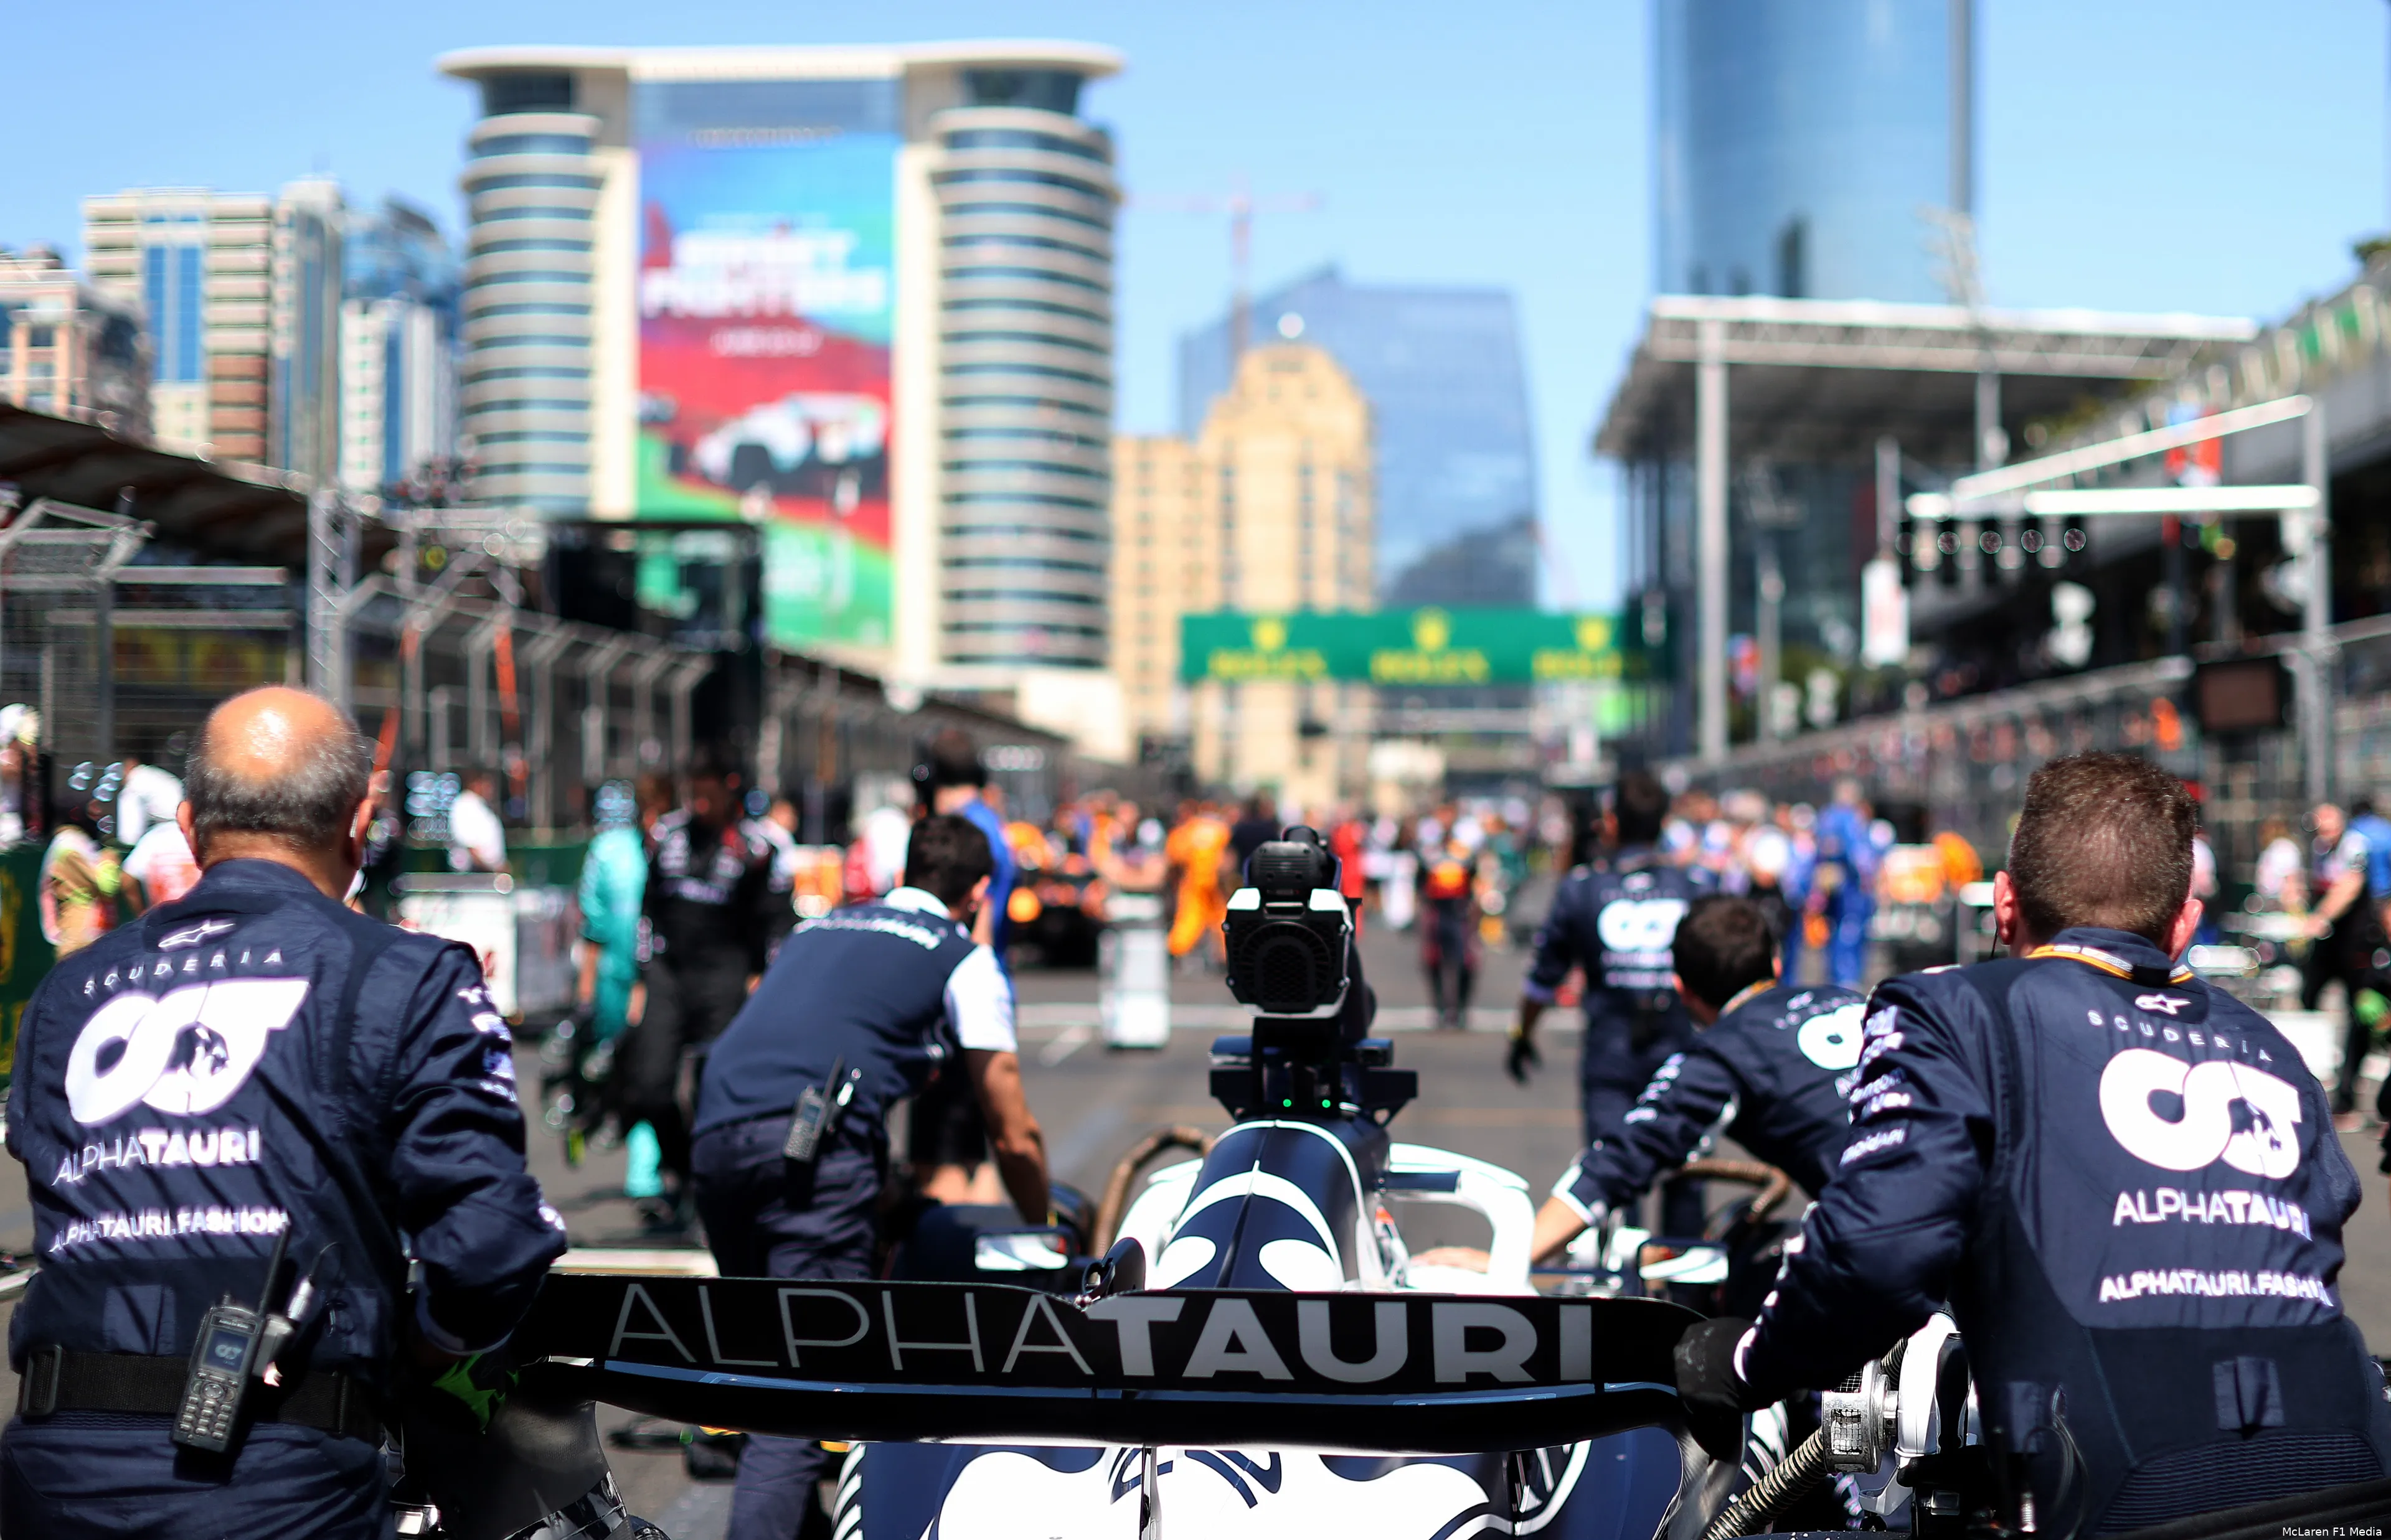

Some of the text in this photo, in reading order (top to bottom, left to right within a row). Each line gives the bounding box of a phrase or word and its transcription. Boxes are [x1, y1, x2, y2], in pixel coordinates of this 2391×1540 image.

[83, 951, 282, 995] SCUDERIA
[2087, 1010, 2273, 1062] SCUDERIA
[52, 1128, 260, 1186] ALPHATAURI
[2113, 1187, 2313, 1242] ALPHATAURI
[2098, 1270, 2334, 1307] ALPHATAURI.FASHI
[605, 1282, 1593, 1383] ALPHATAURI
